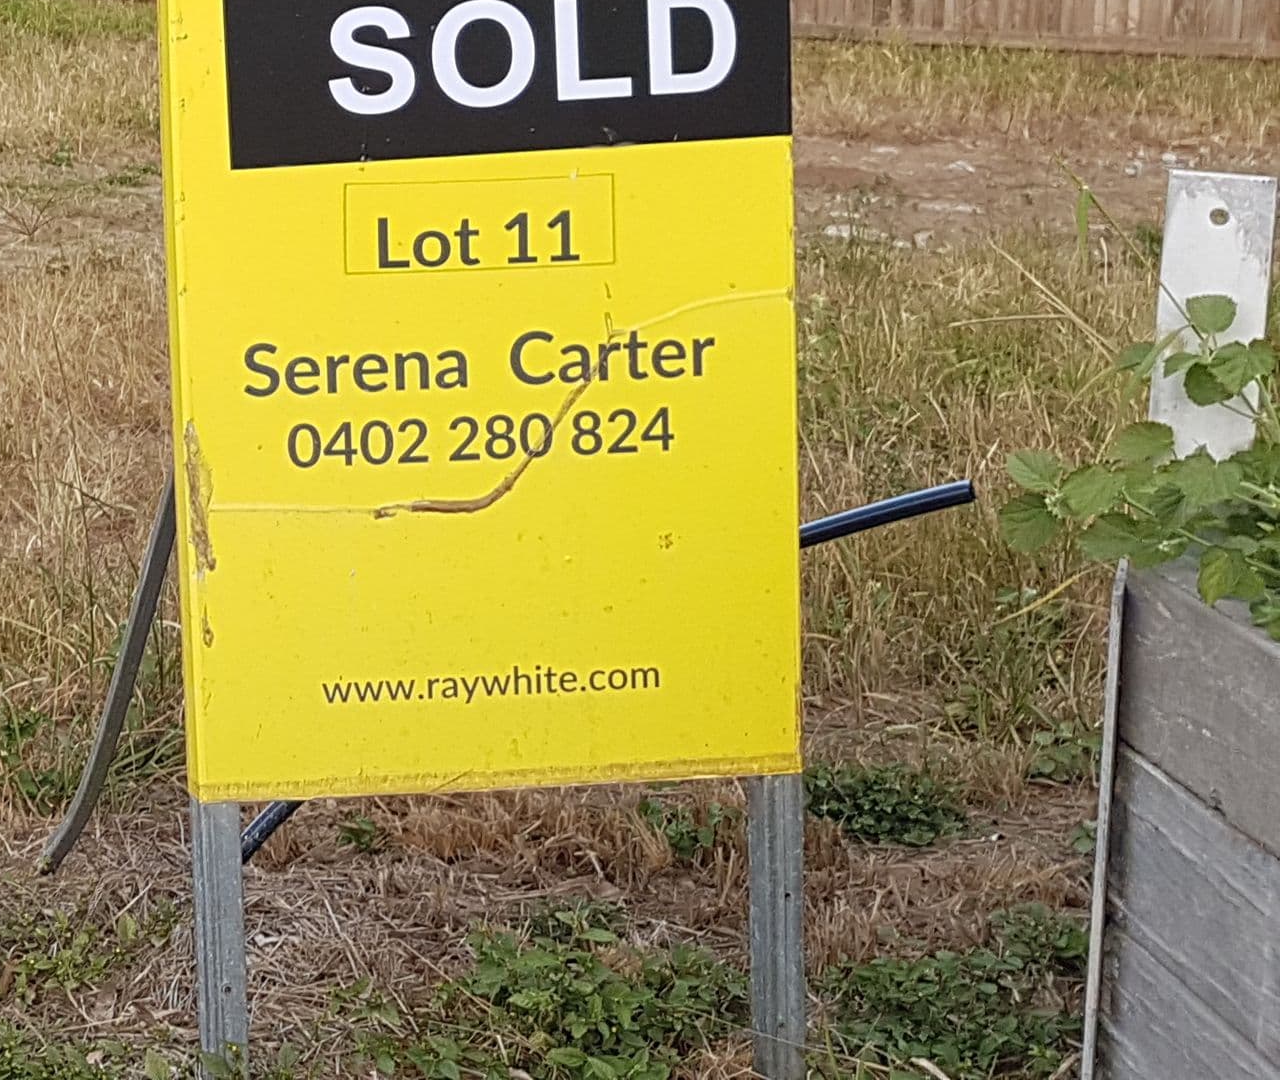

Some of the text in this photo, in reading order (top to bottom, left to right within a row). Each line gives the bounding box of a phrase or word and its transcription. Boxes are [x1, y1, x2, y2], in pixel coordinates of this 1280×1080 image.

[376, 209, 581, 270] Lot 11
[243, 329, 715, 398] Serena Carter
[286, 406, 676, 469] 0402 280 824
[321, 664, 661, 705] www.raywhite.com
